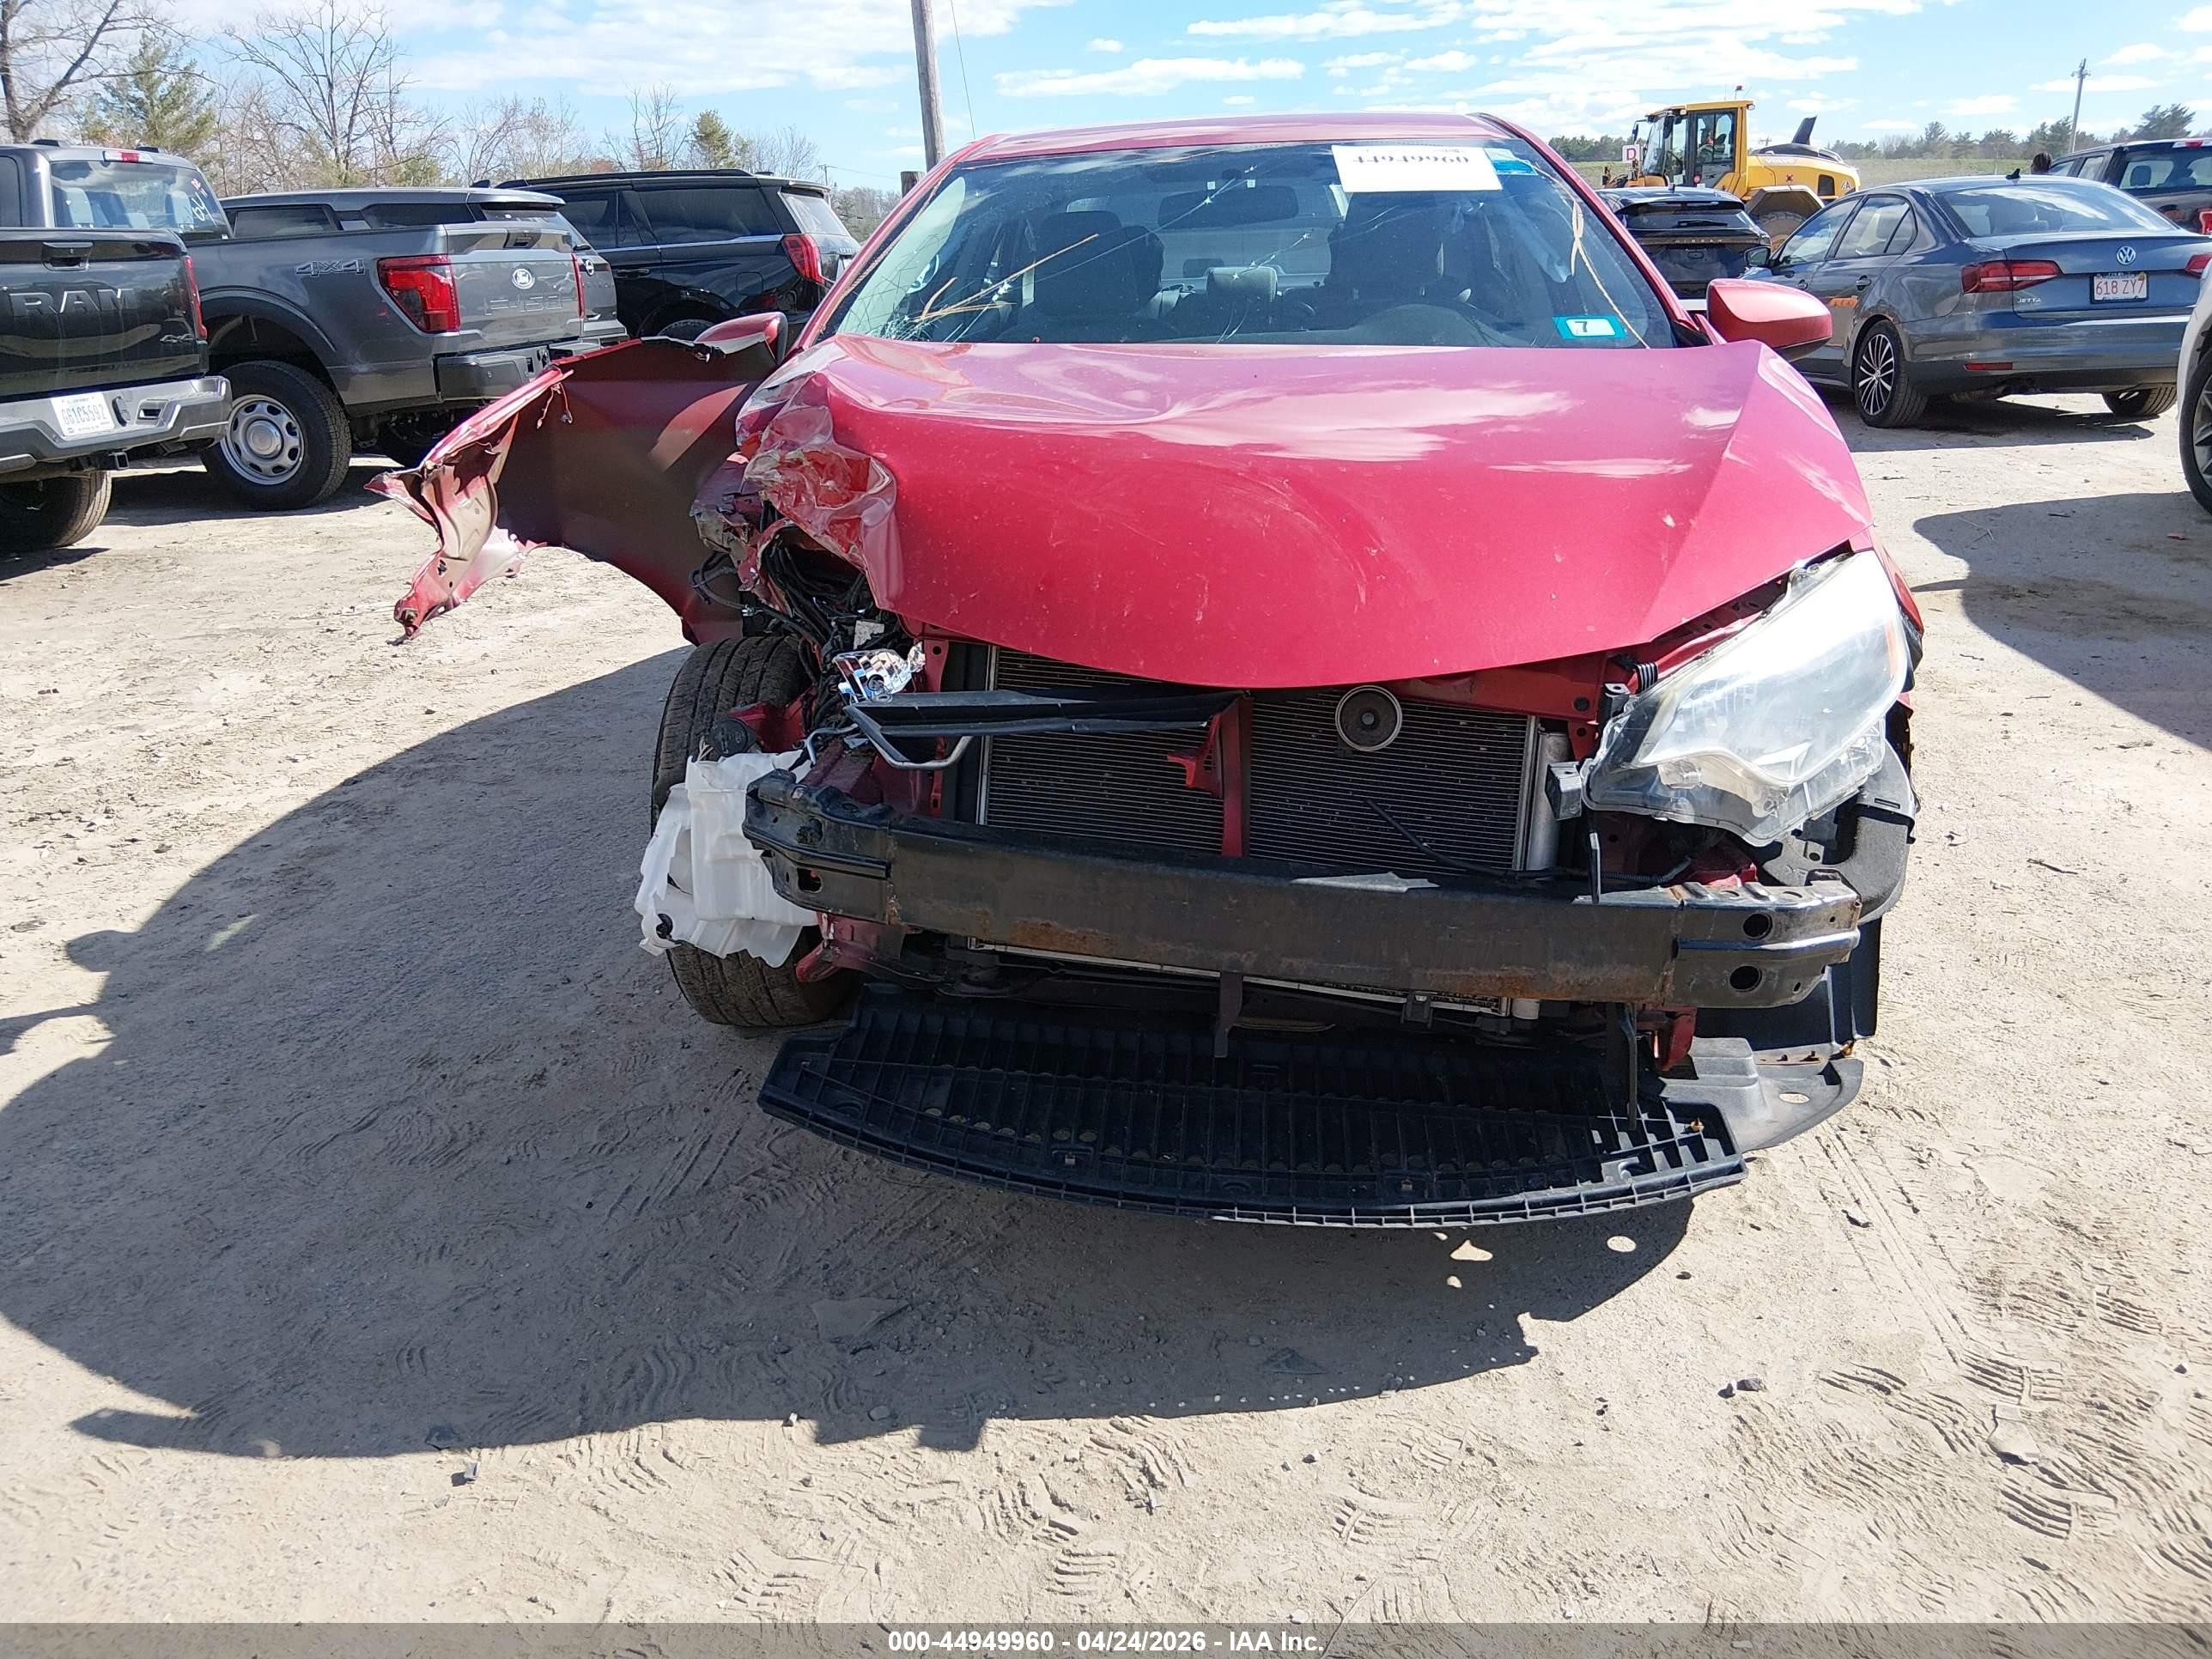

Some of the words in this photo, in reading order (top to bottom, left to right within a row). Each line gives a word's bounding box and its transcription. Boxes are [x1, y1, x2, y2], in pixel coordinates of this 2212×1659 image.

[1626, 148, 1636, 161] D
[2096, 280, 2118, 295] 618
[2122, 279, 2145, 294] ZY7
[9, 289, 136, 316] RAM
[1574, 321, 1588, 333] 7
